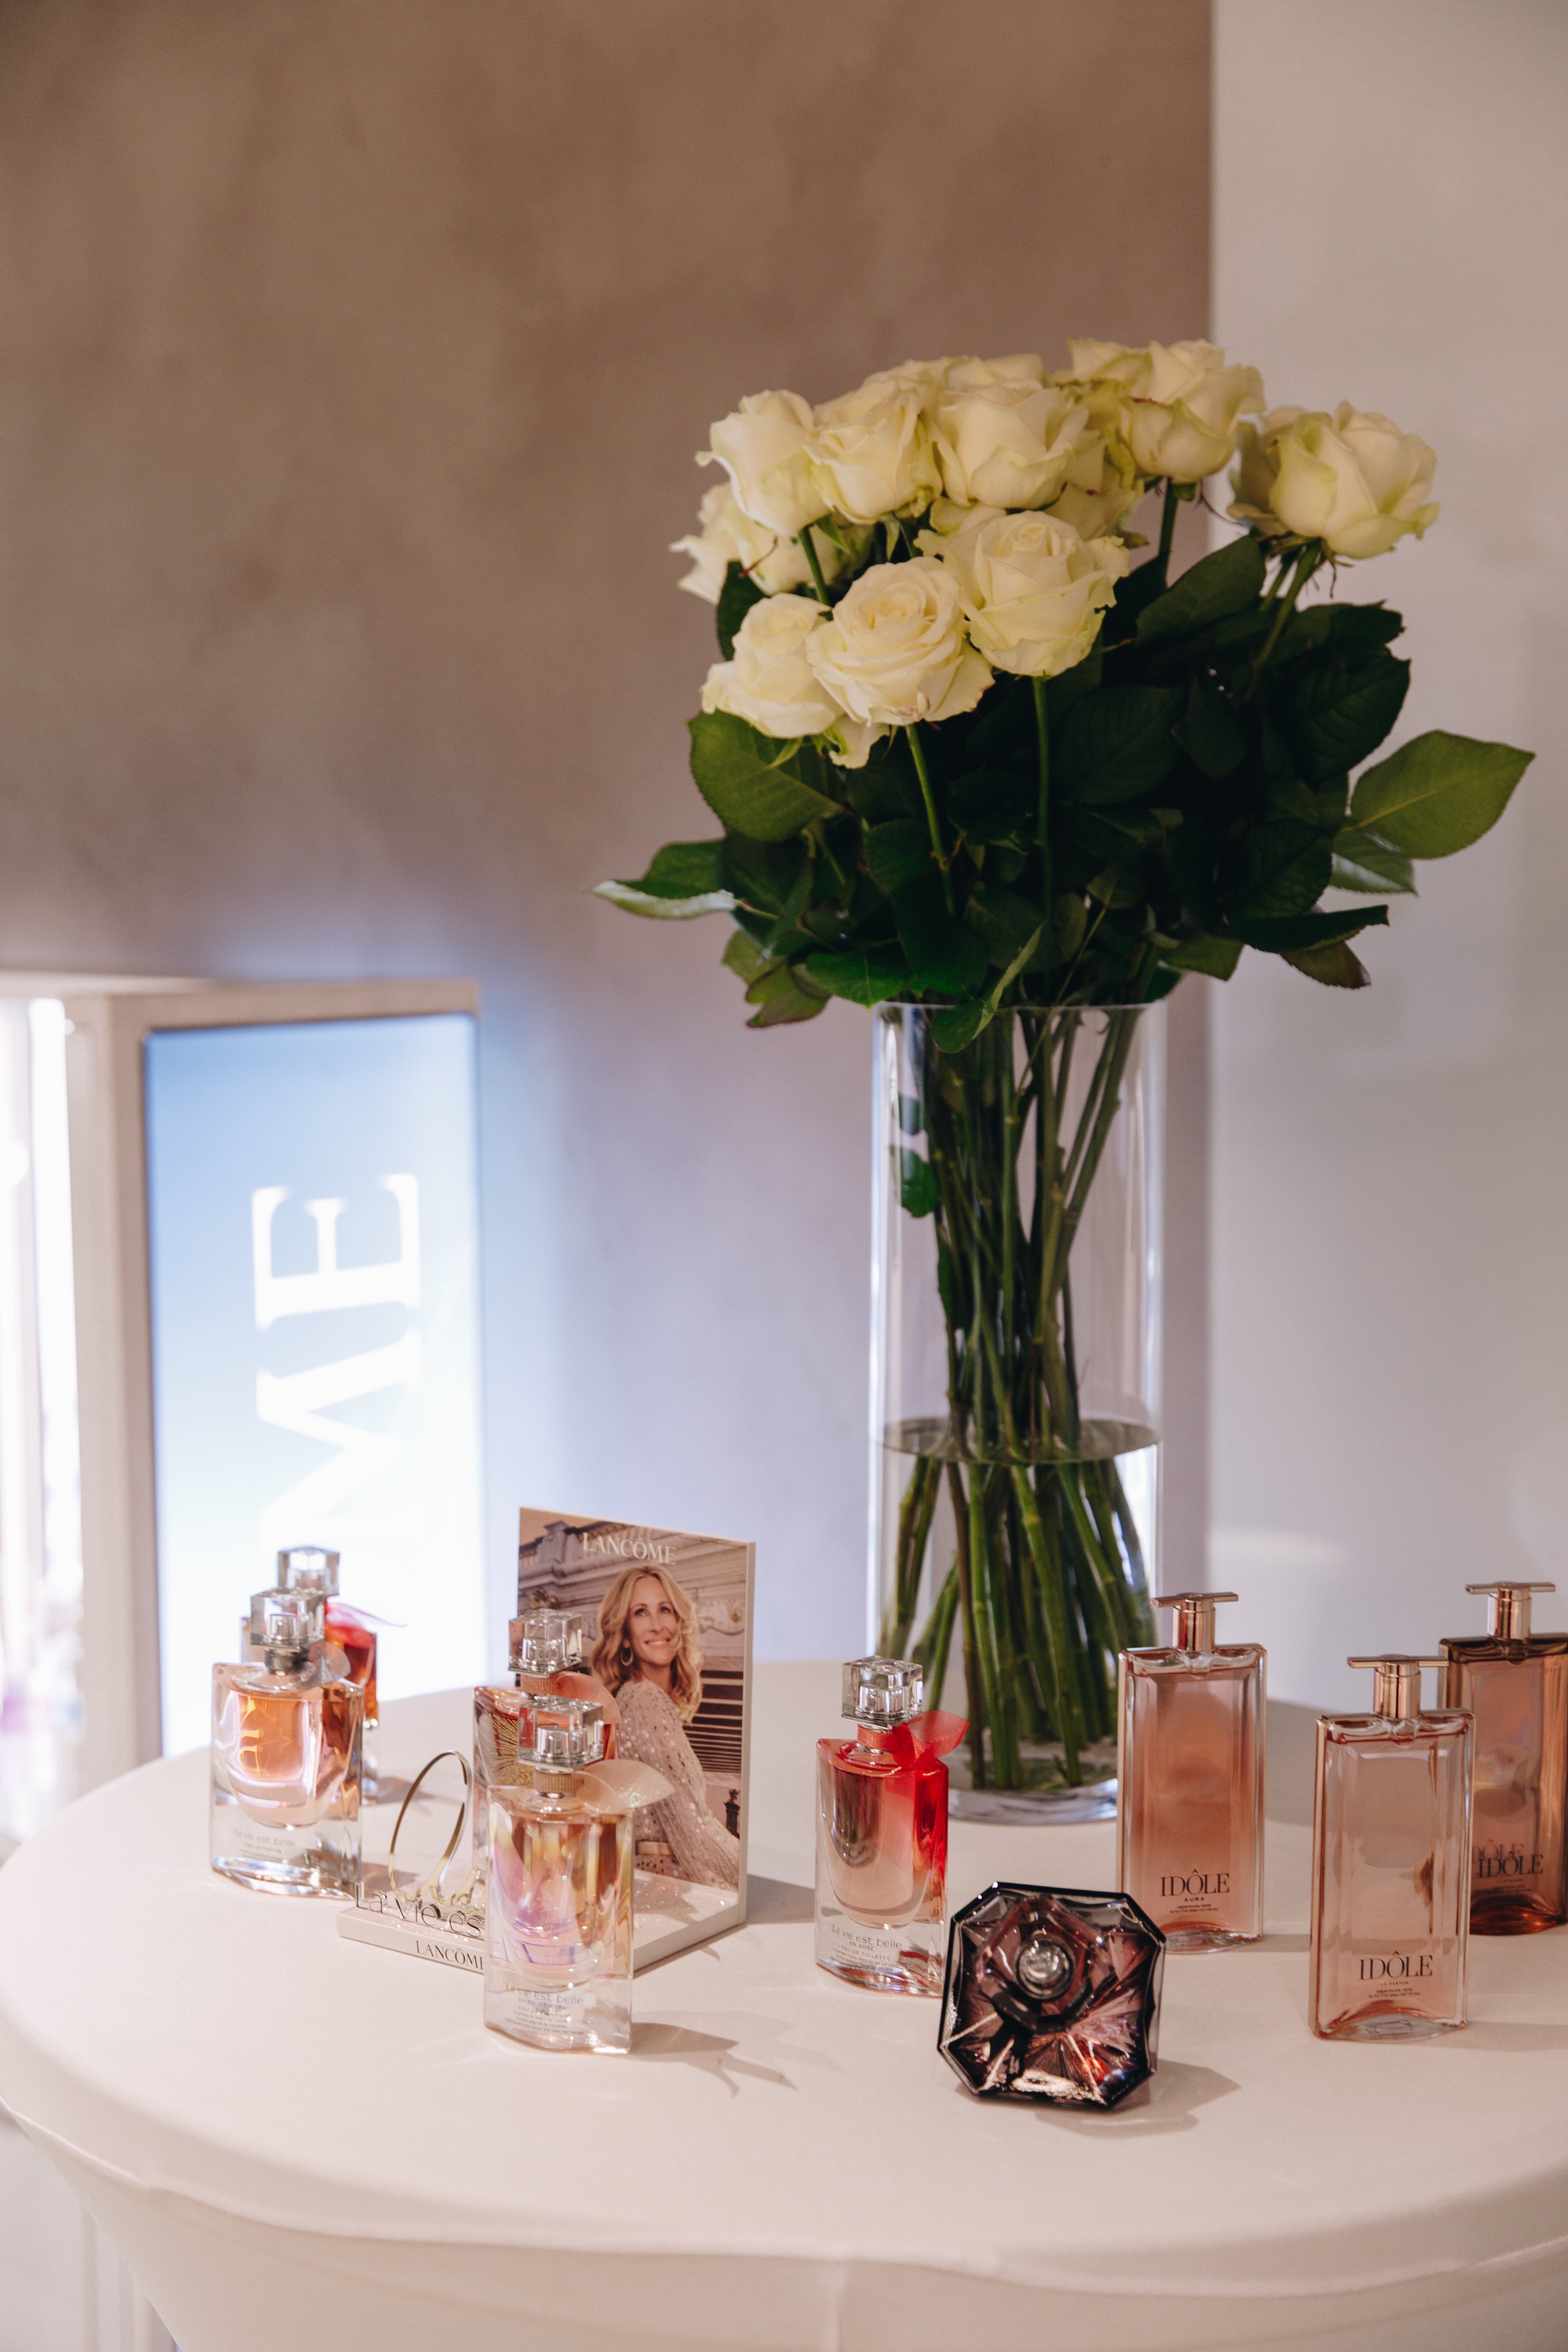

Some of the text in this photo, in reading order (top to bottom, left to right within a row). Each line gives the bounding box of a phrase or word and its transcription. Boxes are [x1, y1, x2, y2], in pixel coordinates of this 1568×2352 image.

[582, 1532, 676, 1565] LANCÔME
[1478, 1850, 1544, 1878] IDÔLE
[1160, 1869, 1230, 1897] IDÔLE
[356, 1883, 484, 1937] La vie es
[832, 1923, 902, 1949] La vie est belle
[1358, 1950, 1433, 1980] IDÔLE
[505, 1982, 584, 2006] La vie est belle
